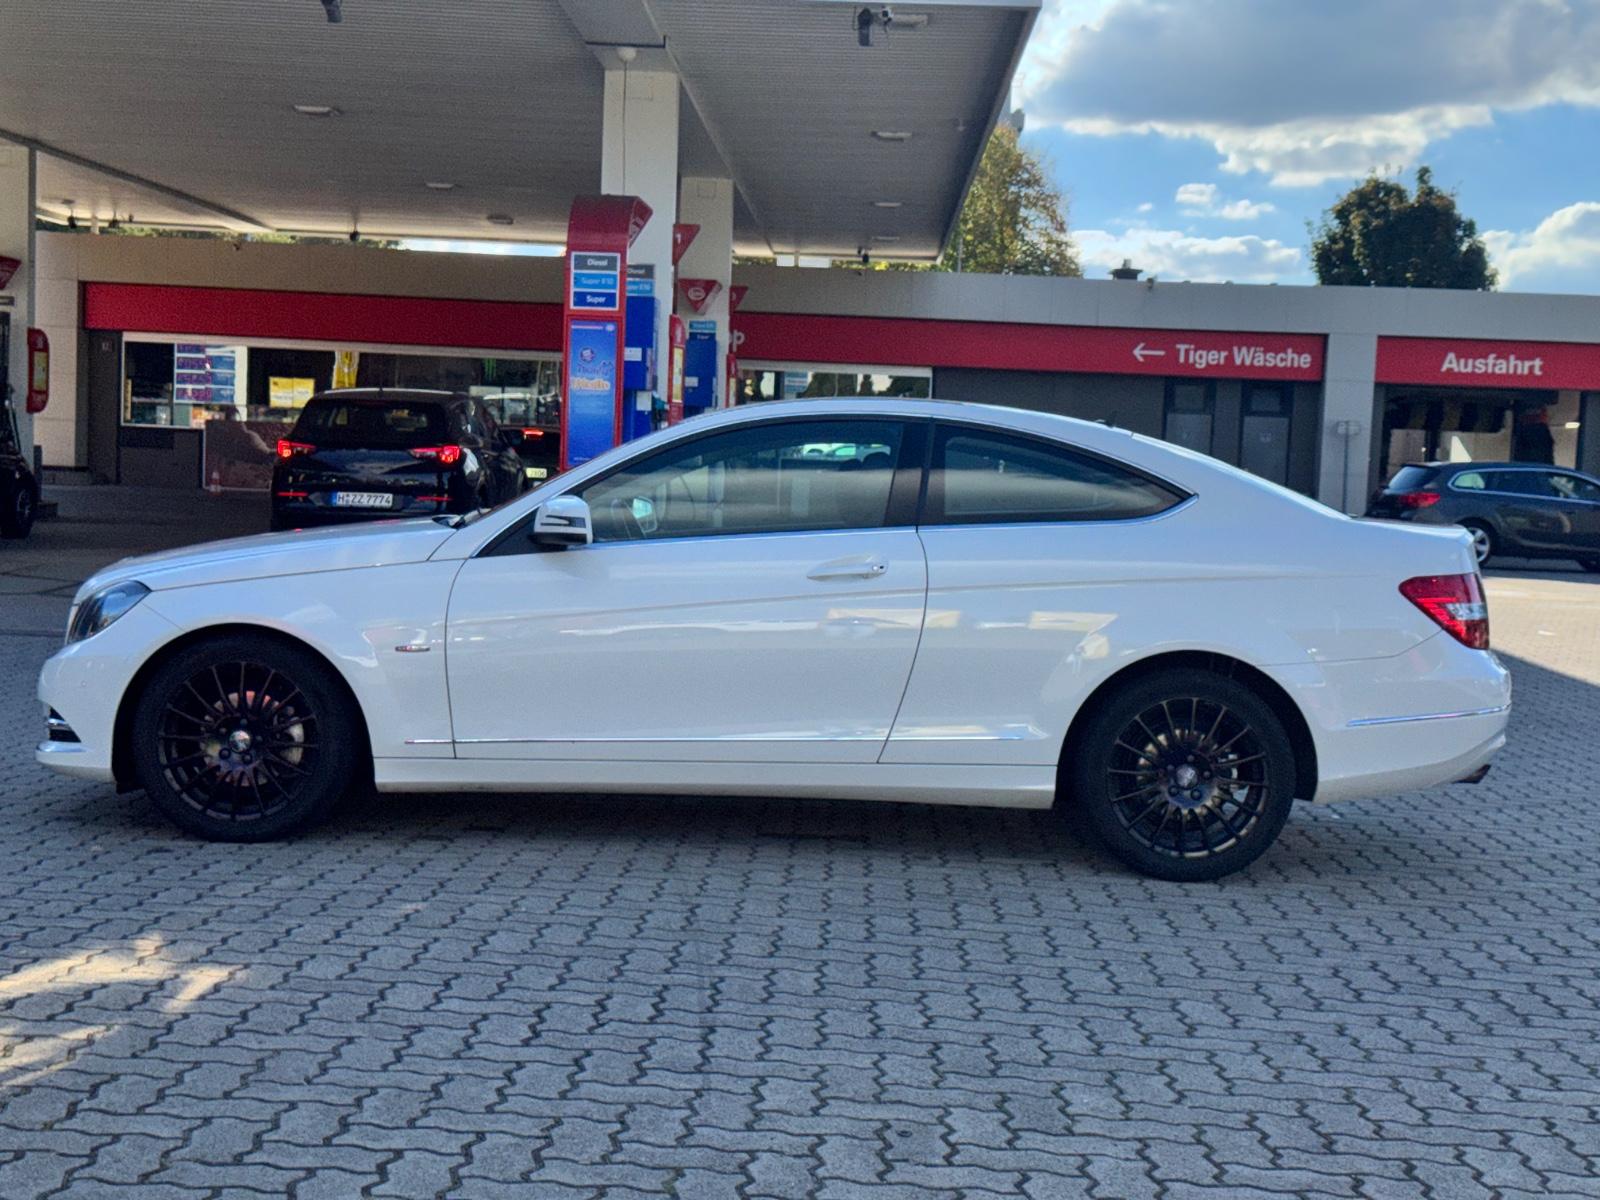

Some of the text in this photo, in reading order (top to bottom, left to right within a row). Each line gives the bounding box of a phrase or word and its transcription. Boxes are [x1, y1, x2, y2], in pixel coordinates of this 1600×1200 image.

[587, 258, 608, 266] Diesel
[586, 294, 606, 304] Super
[1176, 343, 1312, 369] Tiger Wäsche
[1441, 352, 1543, 376] Ausfahrt
